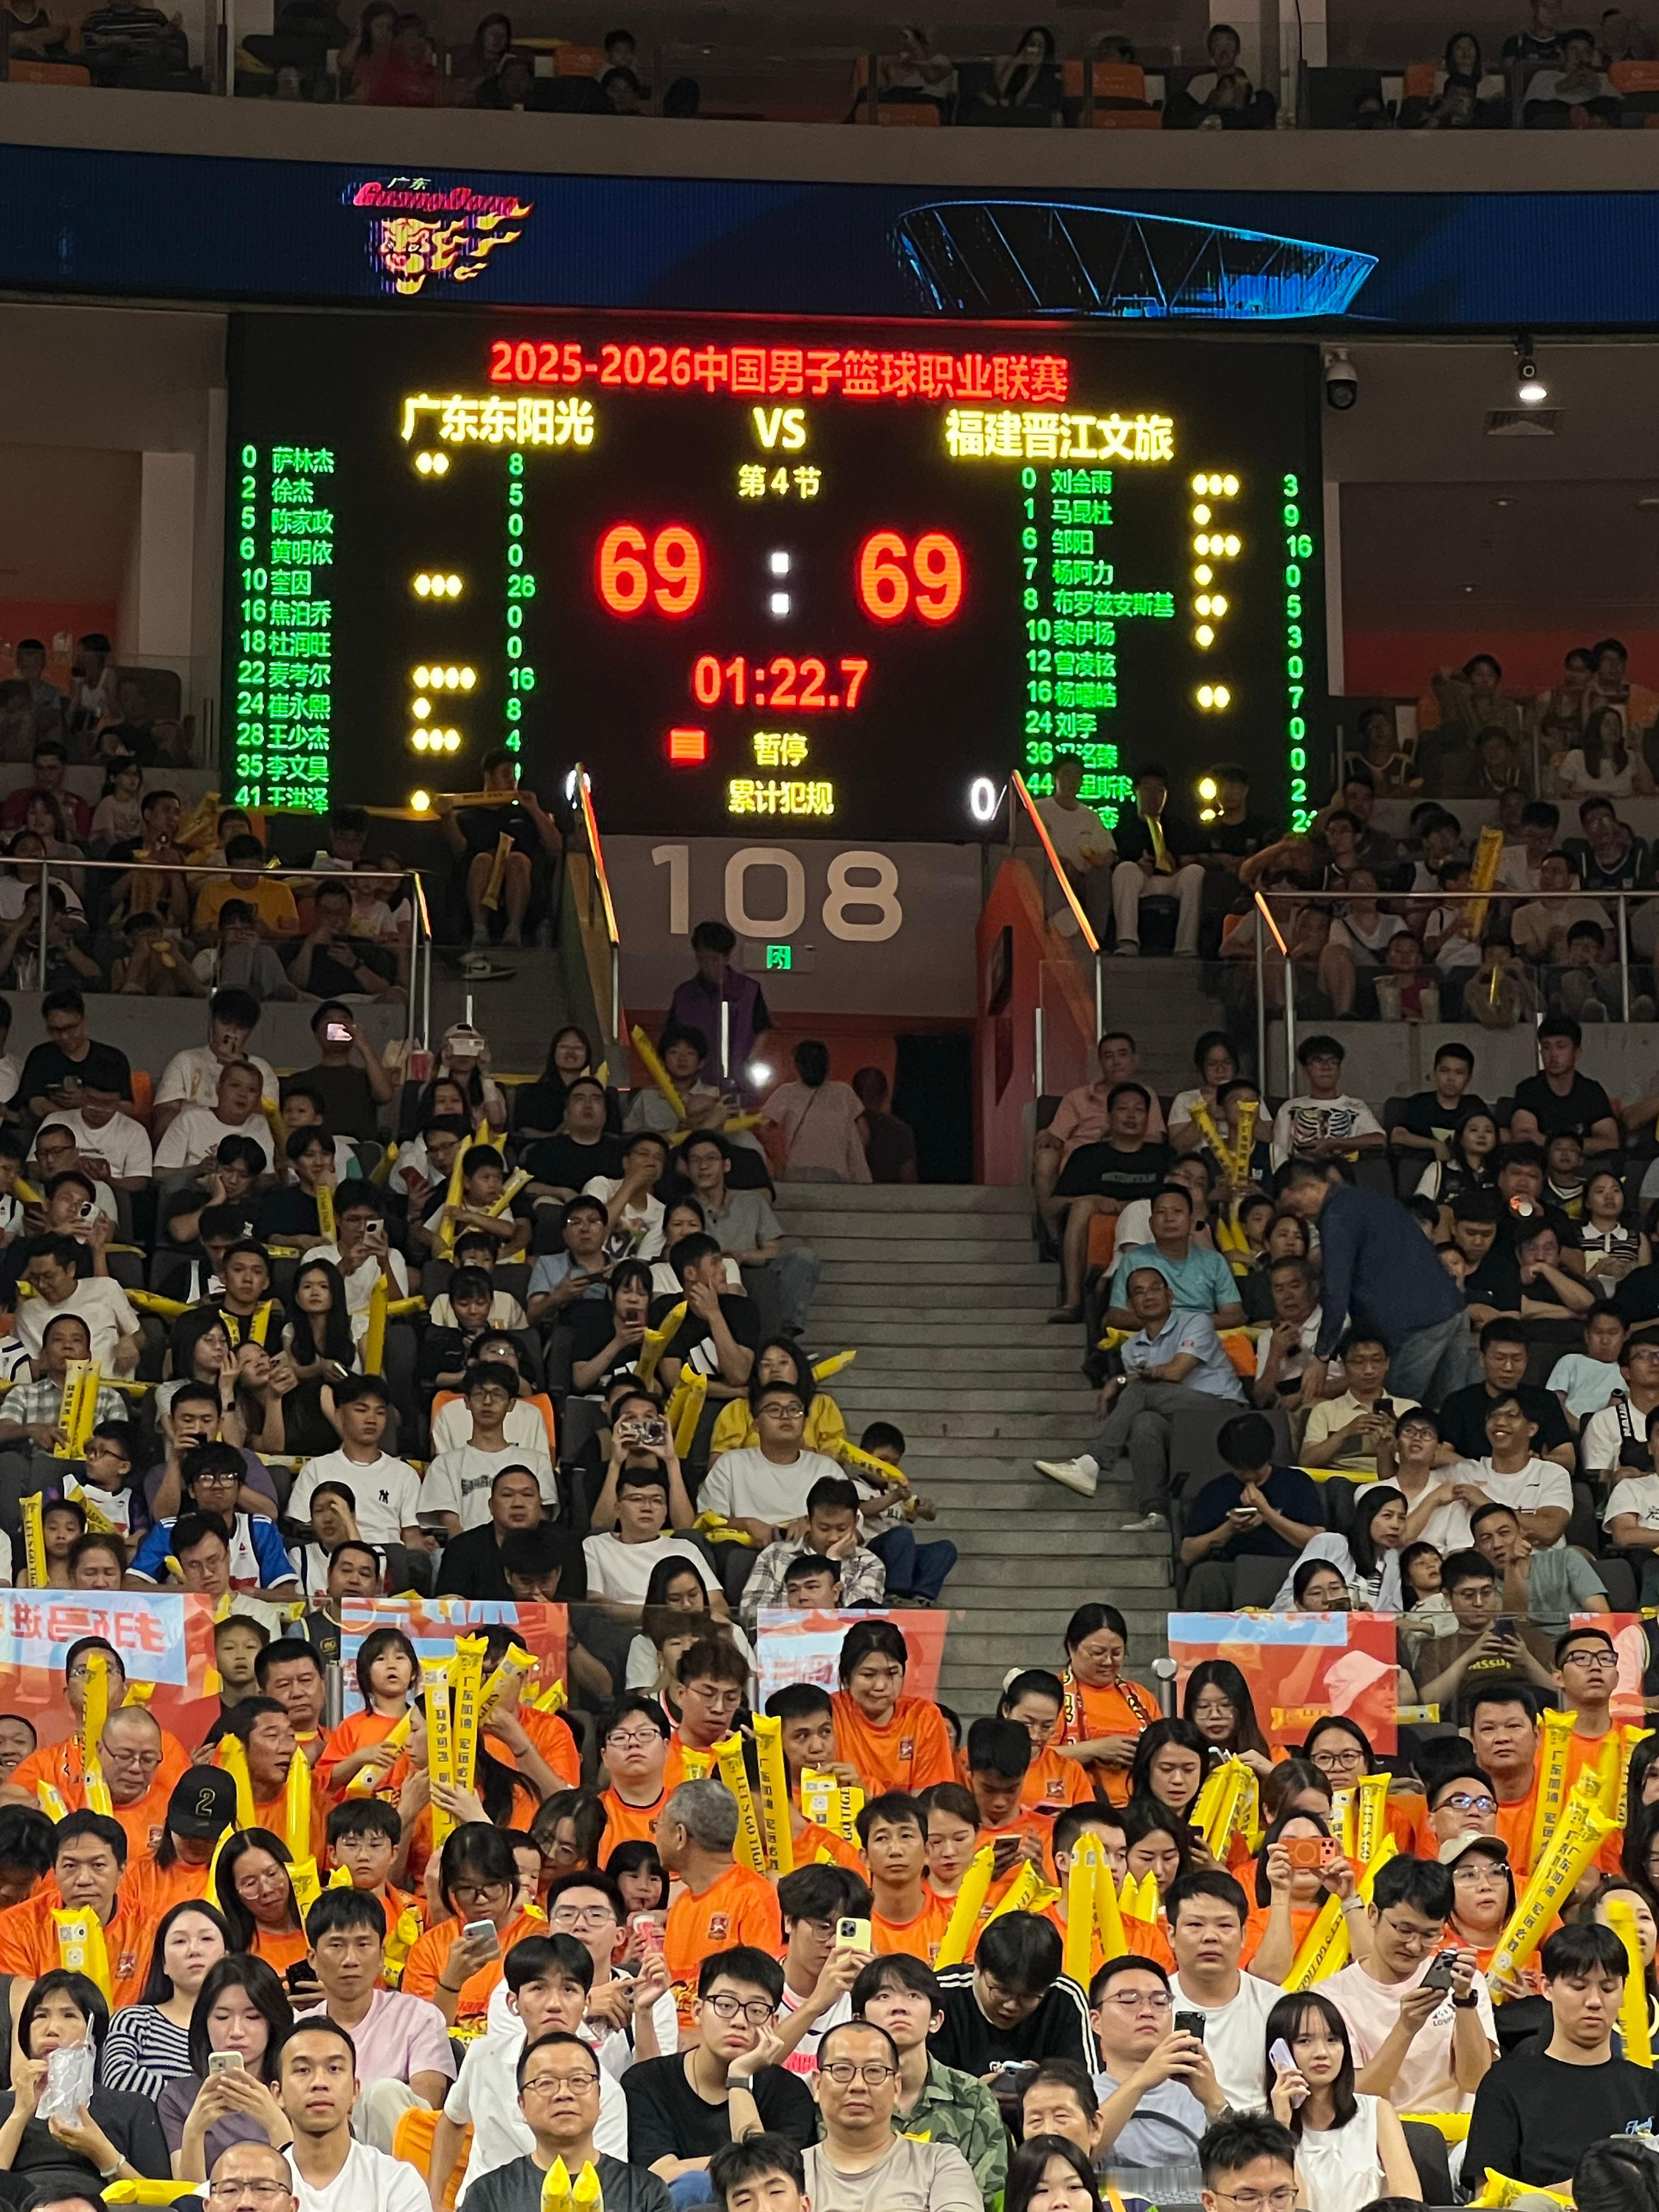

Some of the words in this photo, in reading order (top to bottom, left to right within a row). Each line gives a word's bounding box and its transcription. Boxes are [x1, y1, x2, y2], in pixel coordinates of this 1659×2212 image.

[388, 177, 432, 190] 广东
[489, 341, 1069, 403] 2025-2026中国男子篮球职业联赛
[401, 393, 594, 446] 广东东阳光
[753, 407, 806, 450] VS
[945, 409, 1174, 462] 福建晋江文旅
[242, 445, 256, 468] 0
[272, 447, 334, 473] 萨林杰
[509, 453, 523, 475] 8
[241, 475, 256, 499] 2
[272, 477, 314, 504] 徐杰
[738, 464, 766, 497] 第
[771, 467, 789, 494] 4
[793, 466, 821, 499] 节
[1022, 467, 1037, 493] 0
[1051, 469, 1113, 494] 刘金雨
[1284, 474, 1298, 497] 3
[509, 483, 523, 506] 5
[241, 505, 255, 531] 5
[272, 507, 334, 534] 陈家政
[1024, 498, 1035, 519] 1
[1284, 504, 1299, 527] 9
[509, 514, 523, 537] 0
[240, 537, 255, 560] 6
[271, 538, 333, 565] 黄明依
[1022, 527, 1037, 551] 6
[1052, 528, 1093, 555] 邹阳
[1287, 534, 1312, 557] 16
[508, 544, 523, 567] 0
[242, 568, 267, 591] 10
[597, 523, 705, 618] 69
[859, 531, 963, 622] 69
[1023, 557, 1037, 580] 7
[1052, 559, 1113, 586] 杨阿力
[1286, 565, 1301, 588] 0
[507, 574, 535, 597] 26
[1024, 588, 1038, 611] 8
[1287, 595, 1301, 618] 5
[241, 600, 266, 622] 16
[269, 599, 331, 627] 焦泊乔
[507, 605, 522, 628] 0
[1026, 618, 1051, 641] 10
[1288, 625, 1302, 648] 3
[241, 631, 266, 653] 18
[268, 631, 331, 658] 杜润旺
[507, 636, 522, 658] 0
[1026, 649, 1052, 673] 12
[1288, 656, 1303, 679] 0
[238, 661, 265, 685] 22
[268, 662, 331, 688] 麦考尔
[509, 667, 534, 690] 16
[694, 655, 868, 708] 01:22.7
[1027, 680, 1052, 703] 16
[1289, 686, 1304, 709] 7
[237, 692, 264, 715] 24
[268, 692, 331, 720] 崔永熙
[507, 698, 521, 721] 8
[1025, 710, 1053, 734] 24
[1290, 717, 1305, 740] 0
[236, 724, 264, 746] 28
[267, 724, 330, 750] 王少杰
[506, 729, 521, 752] 4
[754, 732, 808, 766] 暂停
[1026, 741, 1053, 764] 36
[1291, 748, 1305, 771] 0
[236, 753, 263, 778] 35
[1026, 772, 1054, 796] 44
[1291, 778, 1307, 802] 2
[235, 786, 260, 808] 41
[729, 779, 834, 815] 累计犯规
[970, 777, 996, 820] 0
[651, 844, 902, 941] 108
[195, 1788, 216, 1816] 2
